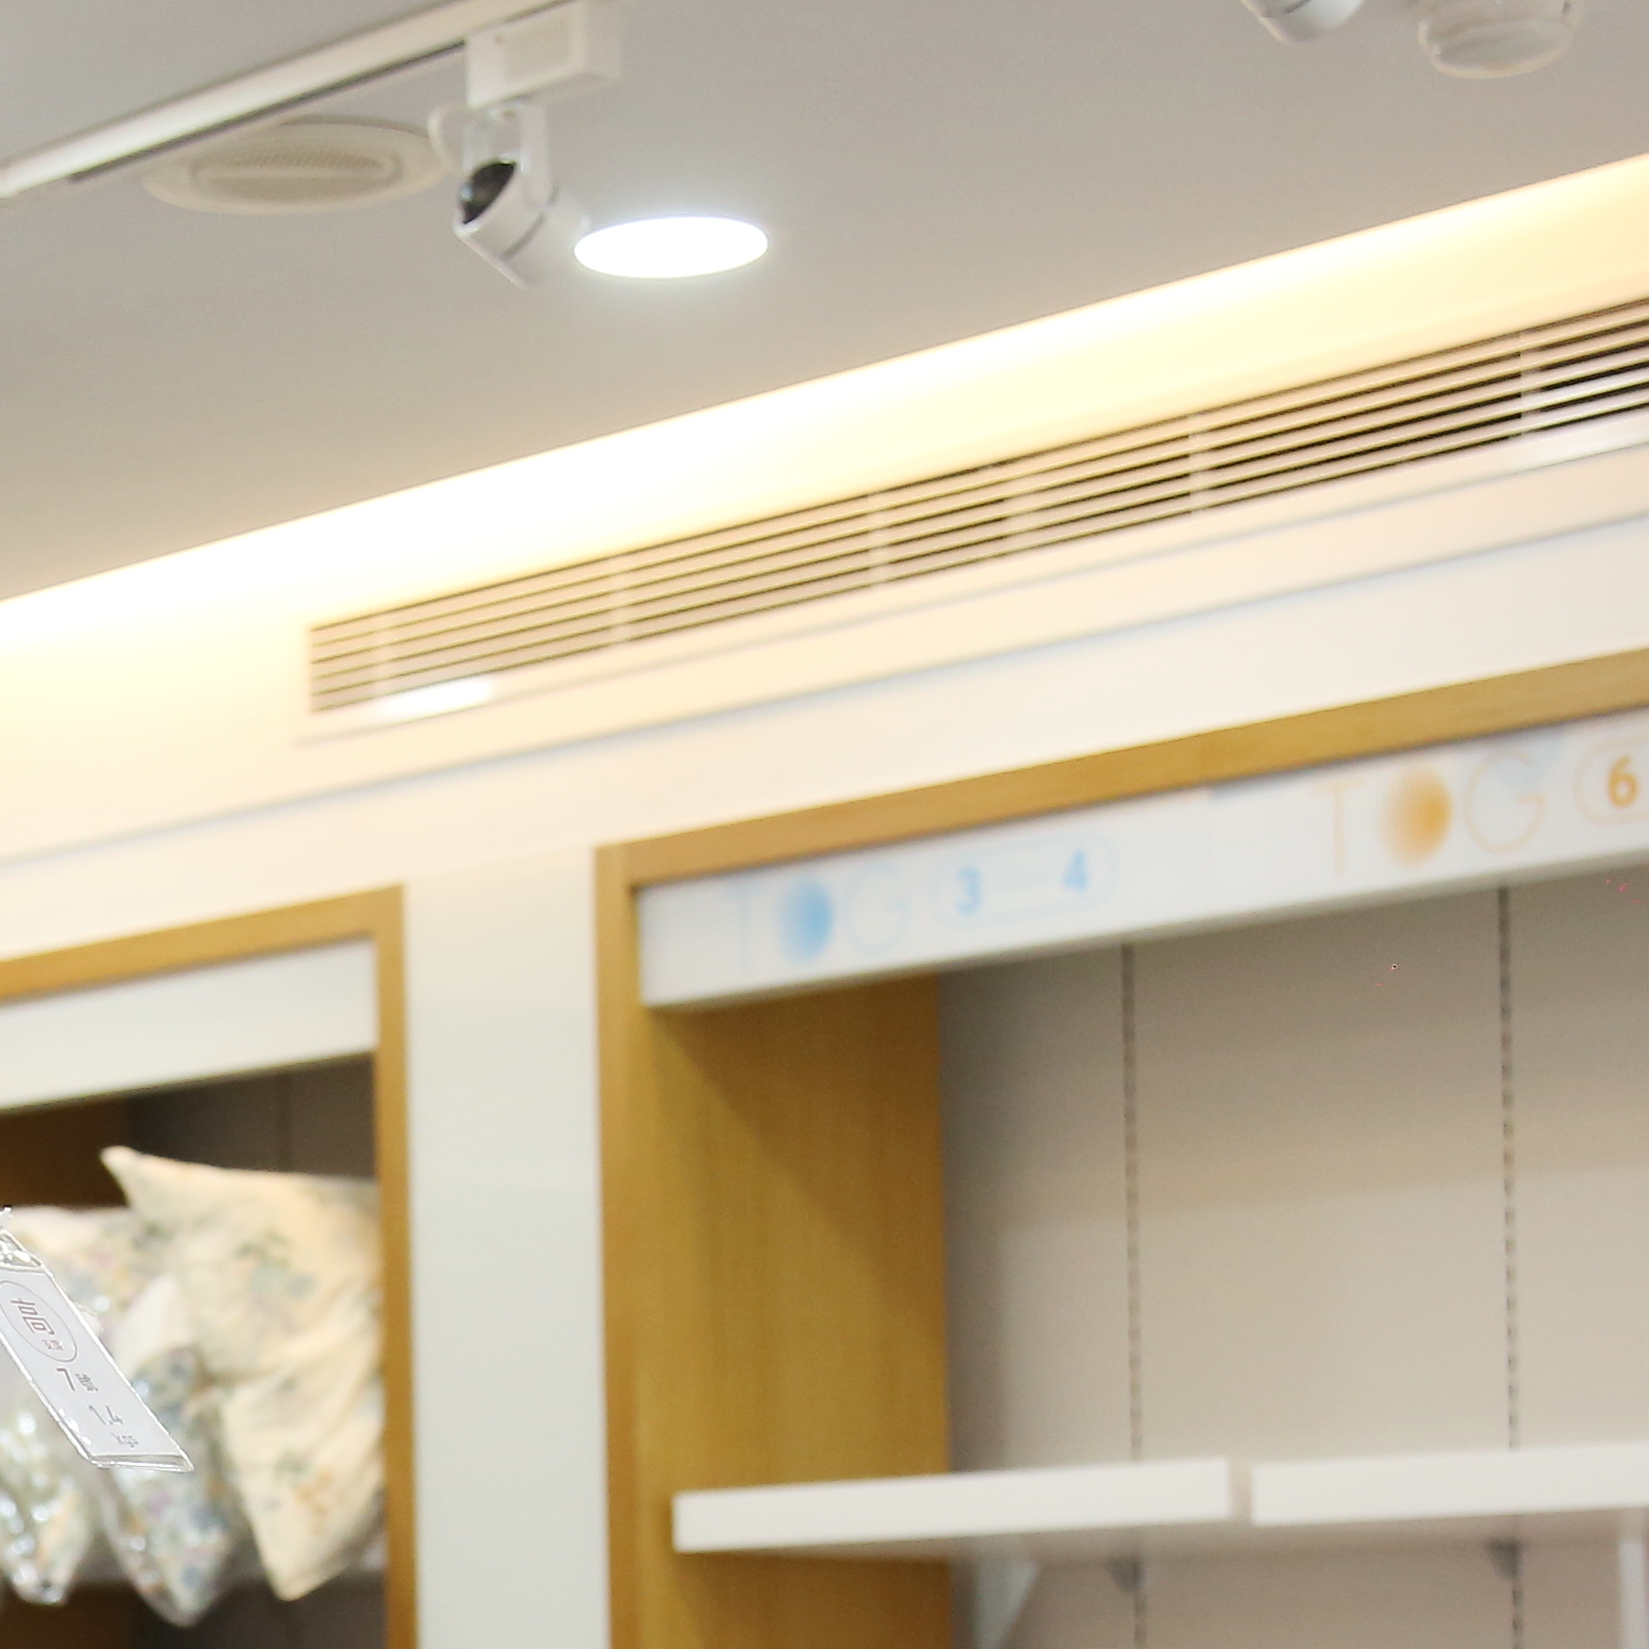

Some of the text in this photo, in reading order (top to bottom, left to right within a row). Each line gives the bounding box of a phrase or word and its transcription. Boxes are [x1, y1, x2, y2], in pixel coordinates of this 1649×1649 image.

[1607, 756, 1639, 807] 6
[10, 1297, 55, 1335] 高
[56, 1367, 76, 1391] 7
[88, 1404, 124, 1425] 1.4
